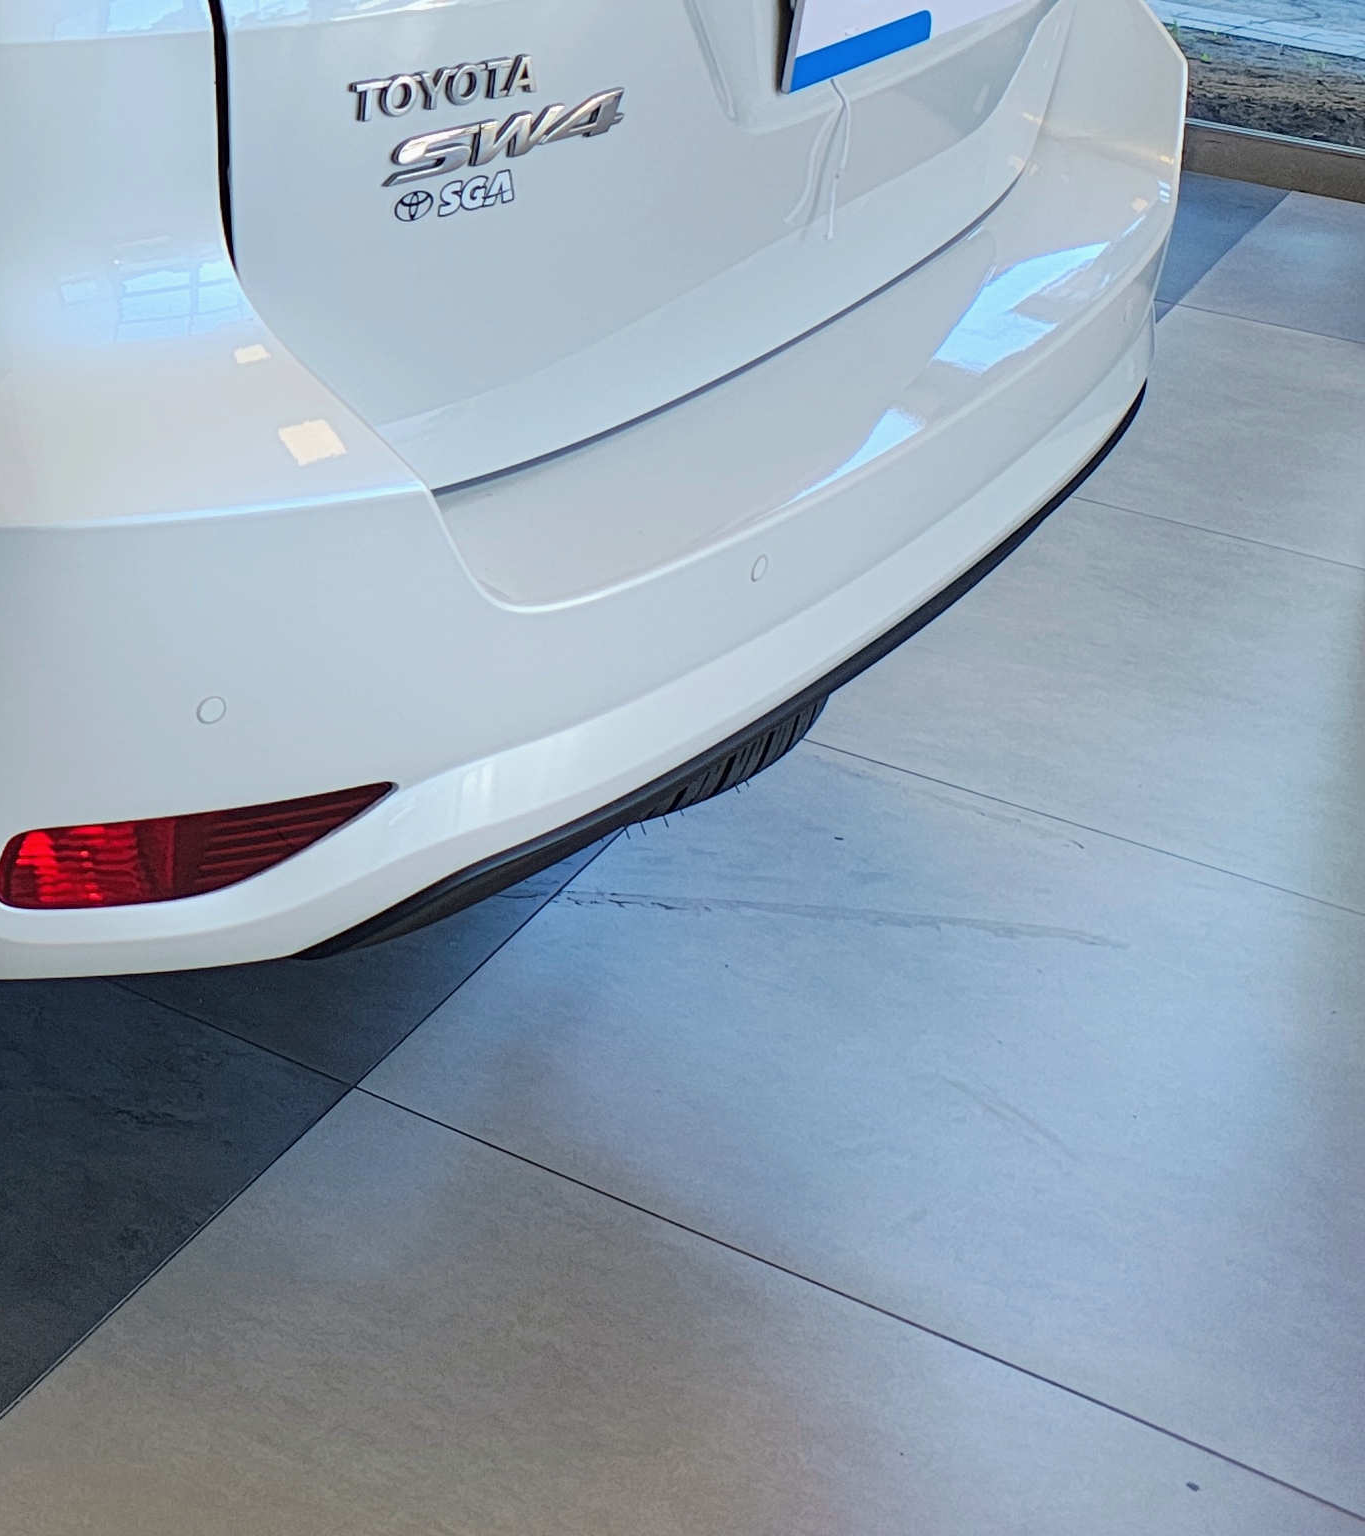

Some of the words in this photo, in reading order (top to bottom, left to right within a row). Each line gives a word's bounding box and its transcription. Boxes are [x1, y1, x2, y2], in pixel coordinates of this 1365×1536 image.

[349, 53, 537, 122] TOYOTA
[380, 86, 626, 187] SW4
[437, 168, 515, 217] SGA
